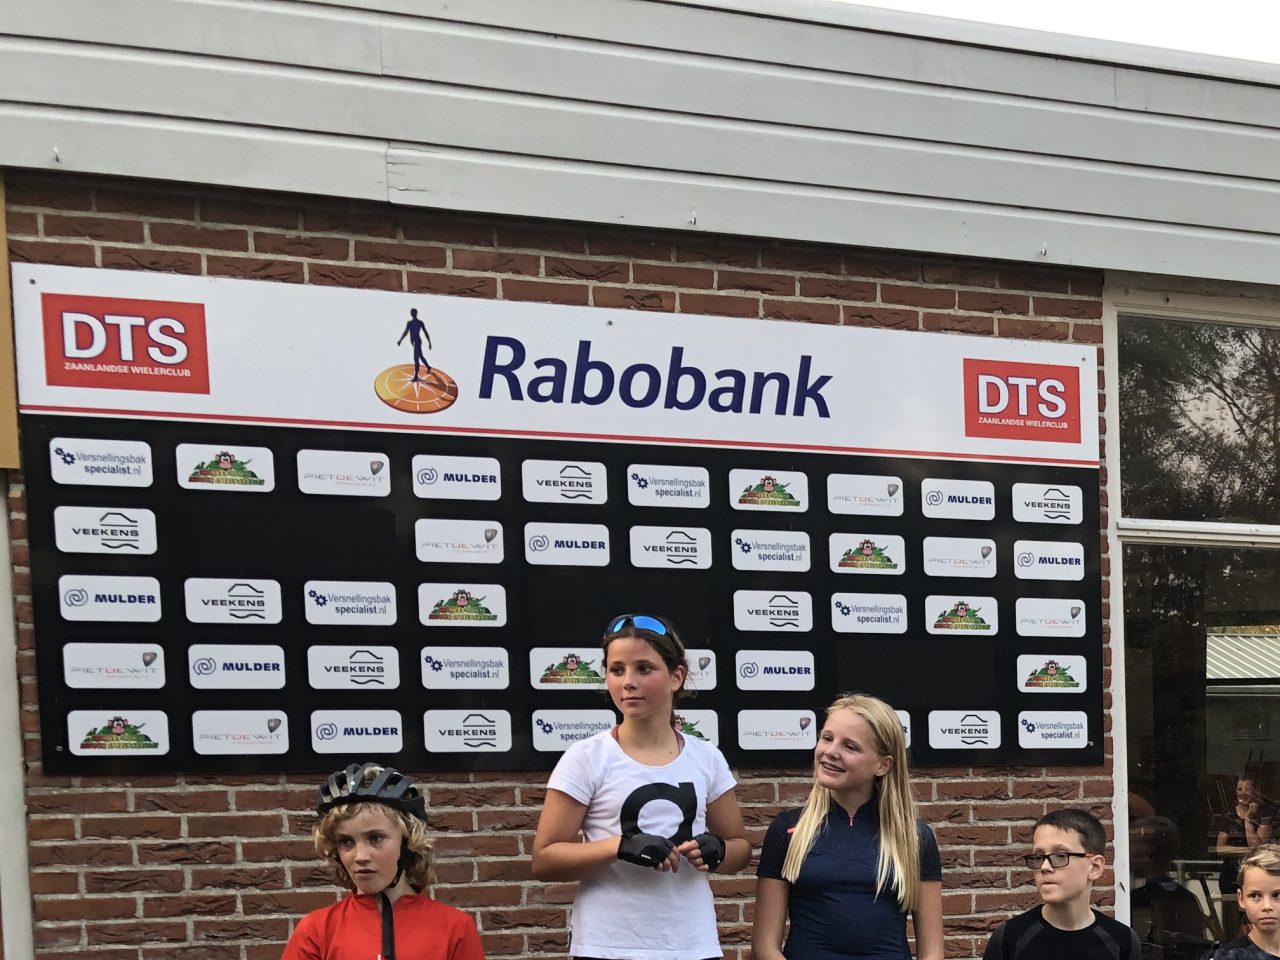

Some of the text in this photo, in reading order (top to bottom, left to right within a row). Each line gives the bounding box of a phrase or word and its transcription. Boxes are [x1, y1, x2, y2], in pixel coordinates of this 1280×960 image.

[62, 311, 188, 365] DTS
[64, 362, 191, 377] ZAANLANDSE WIELERCLUB
[479, 335, 834, 418] Rabobank
[978, 374, 1067, 419] DTS
[978, 416, 1069, 429] ZAANLANDSE WIELERCLUB
[75, 451, 147, 465] Versnellingsbak
[84, 464, 142, 475] specialist.nl
[443, 473, 497, 484] MULDER
[536, 479, 593, 488] VEEKENS
[649, 476, 706, 488] Versnellingsbak
[655, 487, 702, 497] specialist.nl
[947, 495, 992, 505] MULDER
[1023, 501, 1071, 510] VEEKENS
[71, 527, 139, 537] VEEKENS
[554, 540, 606, 550] MULDER
[643, 545, 698, 553] VEEKENS
[751, 540, 807, 552] Versnellingsbak
[757, 551, 803, 561] specialist.nl
[1038, 556, 1081, 566] MULDER
[94, 593, 156, 604] MULDER
[201, 599, 265, 607] VEEKENS
[327, 593, 392, 605] Versnellingsbak
[334, 604, 387, 615] specialist.nl
[746, 609, 799, 617] VEEKENS
[850, 604, 904, 615] Versnellingsbak
[856, 614, 900, 624] specialist.nl
[221, 662, 281, 672] MULDER
[323, 665, 385, 673] VEEKENS
[443, 658, 504, 670] Versnellingsbak
[449, 669, 500, 680] specialist.nl
[763, 666, 812, 675] MULDER
[342, 727, 399, 736] MULDER
[553, 721, 612, 732] Versnellingsbak
[1035, 721, 1084, 732] Versnellingsbak
[1040, 731, 1081, 740] specialist.nl
